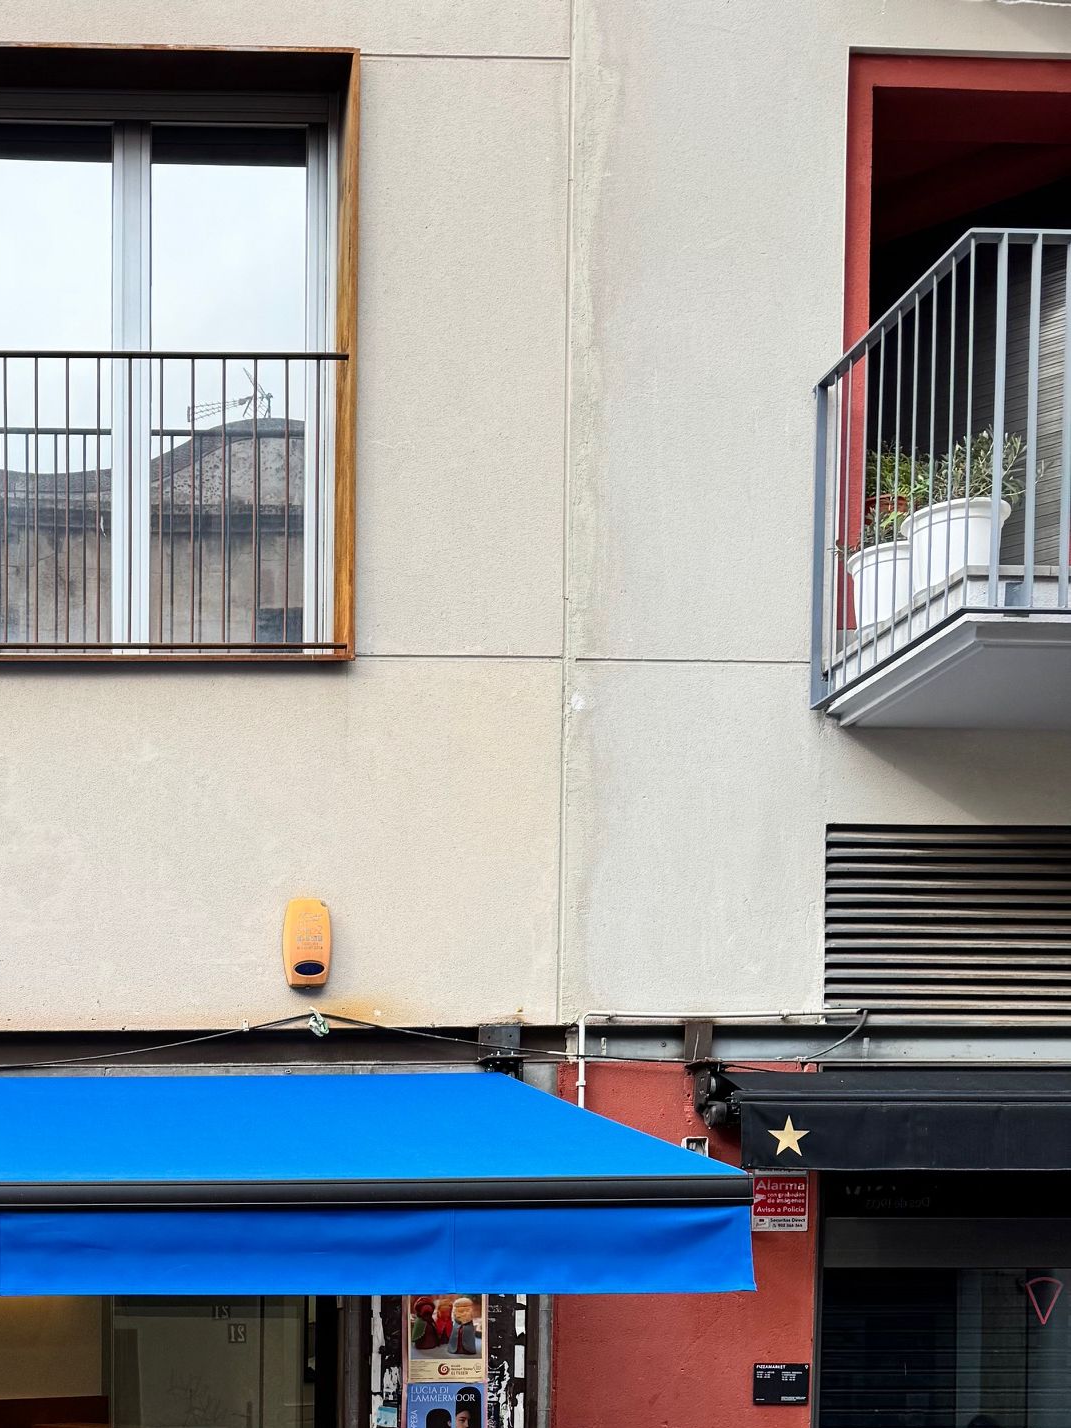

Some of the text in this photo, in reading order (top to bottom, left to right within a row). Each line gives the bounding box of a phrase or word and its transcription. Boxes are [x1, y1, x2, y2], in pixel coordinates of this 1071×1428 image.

[755, 1179, 805, 1191] Alarma
[410, 1386, 449, 1394] LUCIA DI
[410, 1393, 476, 1402] LAMMERMOOR
